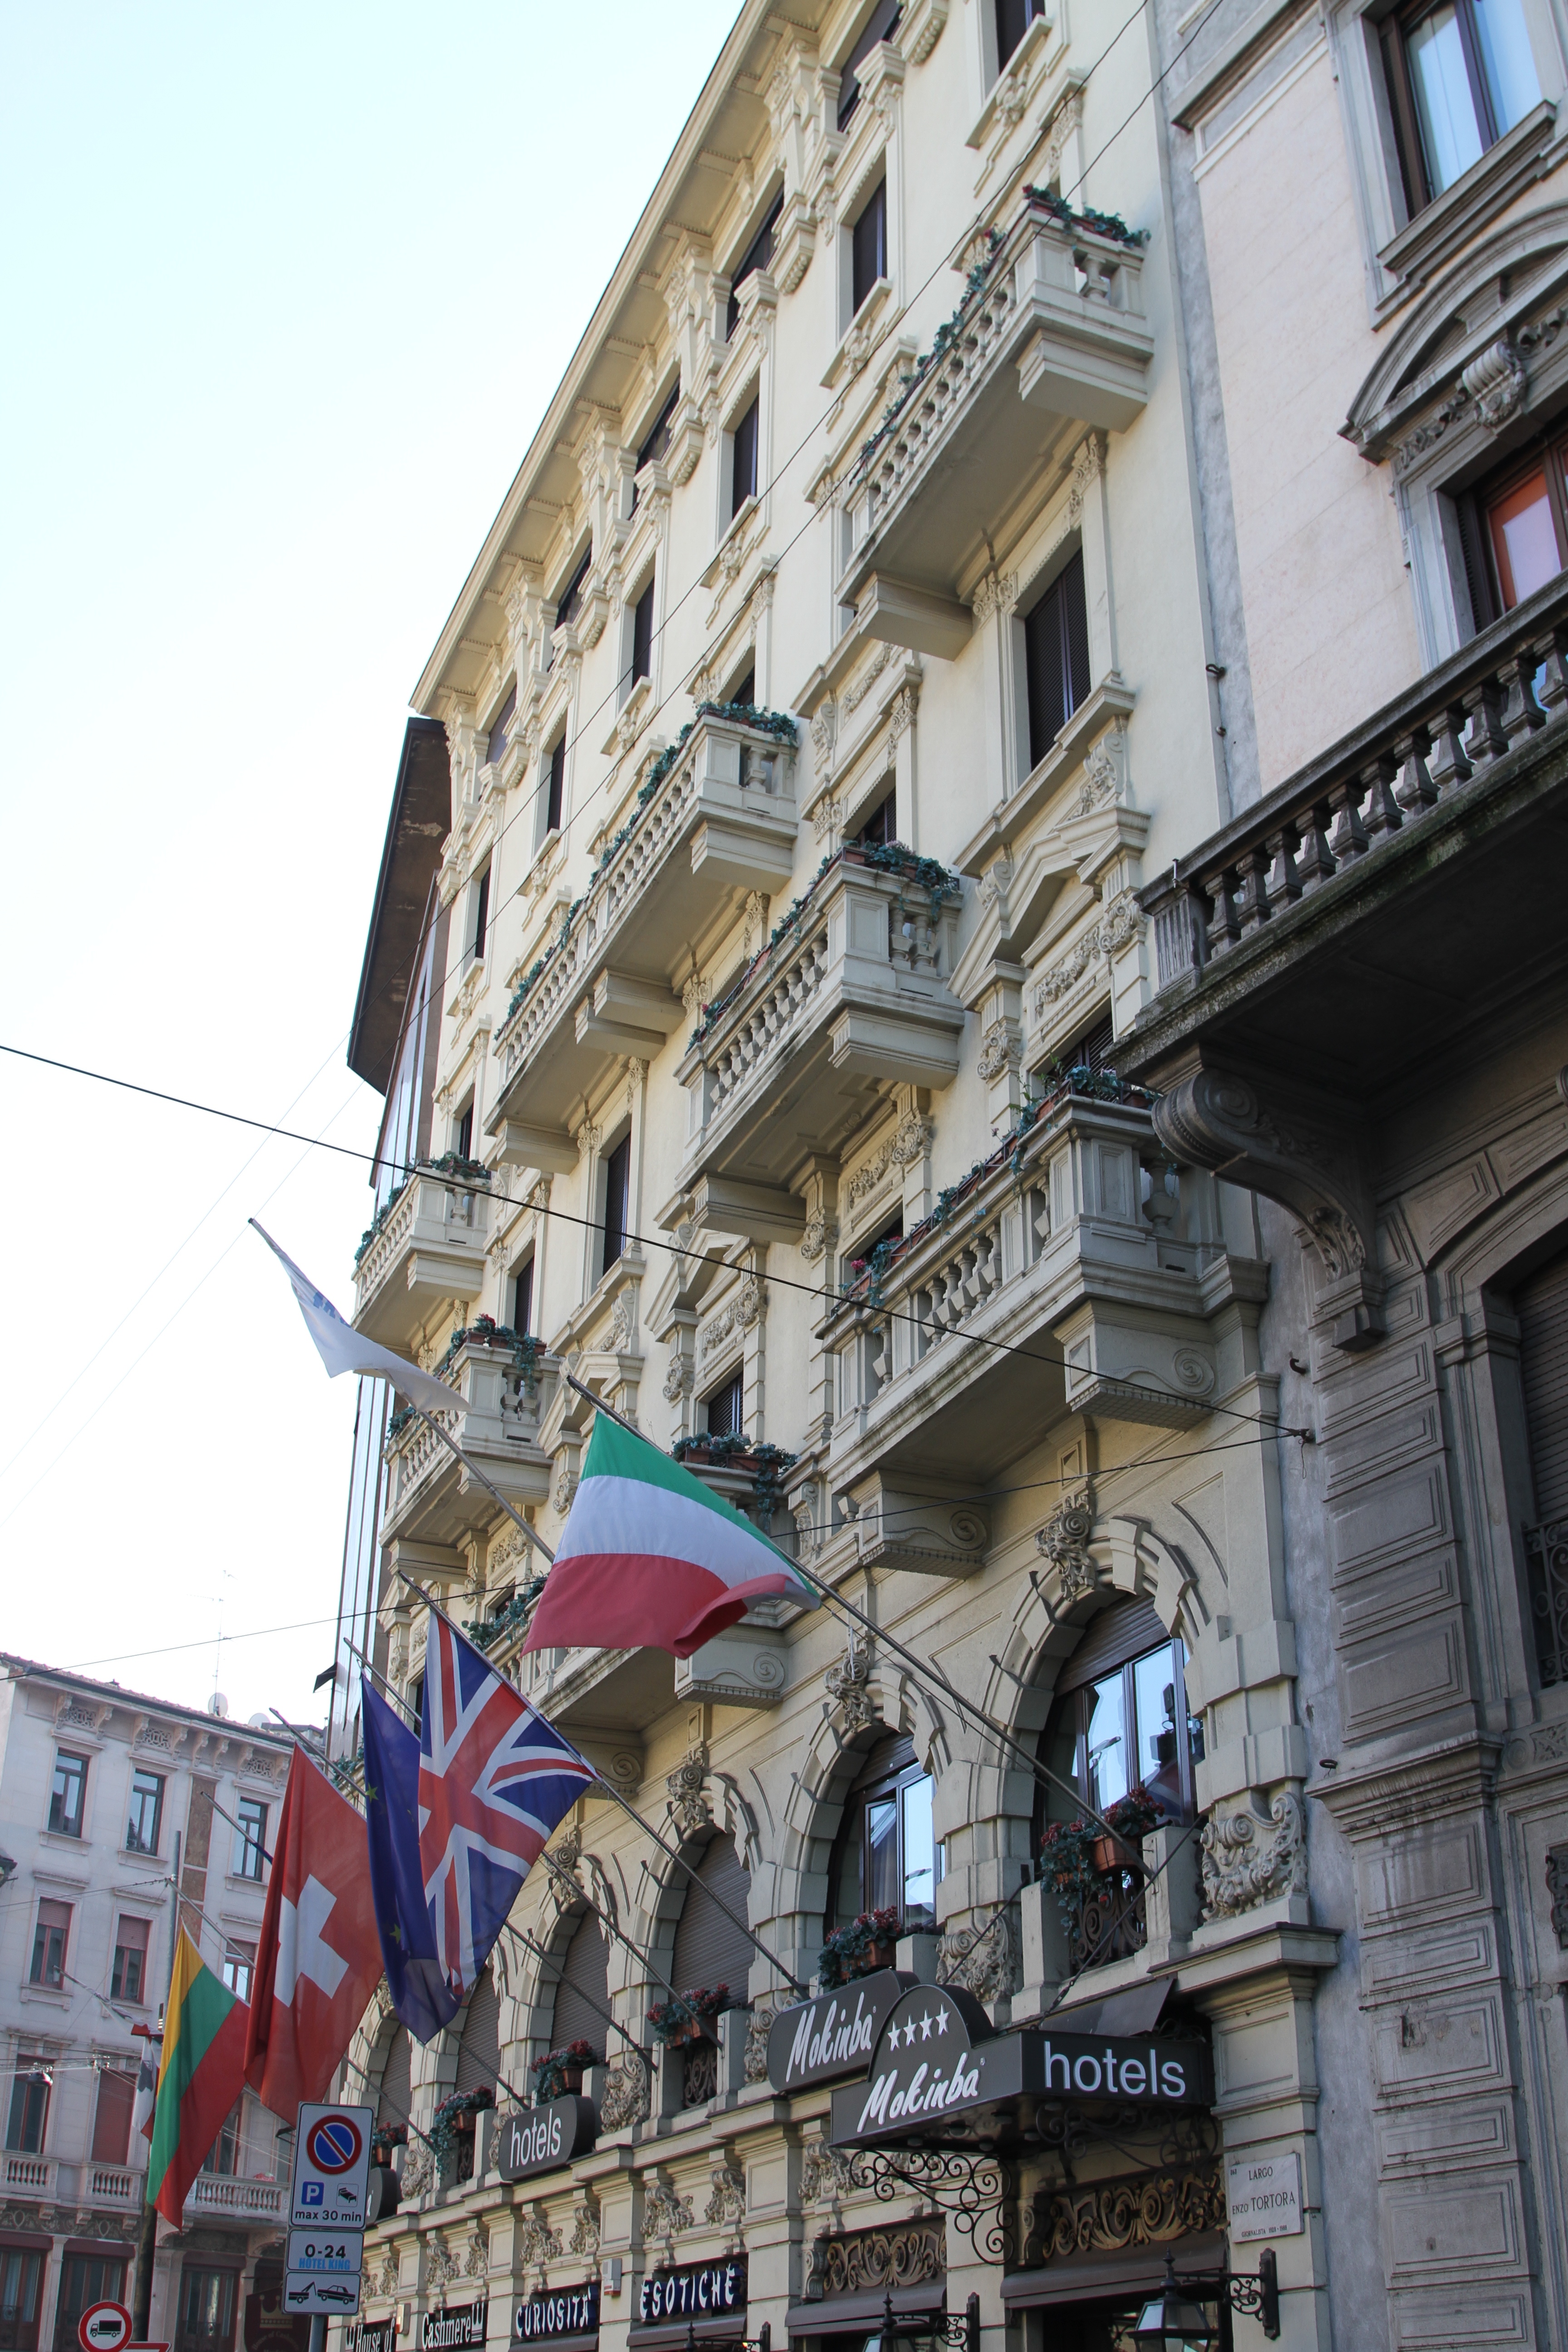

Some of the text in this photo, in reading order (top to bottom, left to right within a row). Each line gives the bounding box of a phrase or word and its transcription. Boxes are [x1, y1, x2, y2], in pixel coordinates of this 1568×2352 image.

[1044, 2041, 1186, 2097] hotels
[510, 2108, 562, 2168] hotels
[1249, 2166, 1273, 2180] LARGO
[1232, 2191, 1295, 2215] ENZO TORTORA
[295, 2210, 362, 2221] max 30 min
[1241, 2228, 1266, 2237] GIORNALISTA
[305, 2244, 346, 2259] 0-24
[299, 2257, 351, 2270] HOTEL KING
[640, 2263, 735, 2319] ESOTICHE
[251, 2335, 268, 2351] House
[268, 2330, 275, 2338] of
[356, 2318, 395, 2352] House of
[421, 2309, 470, 2351] Cashmere
